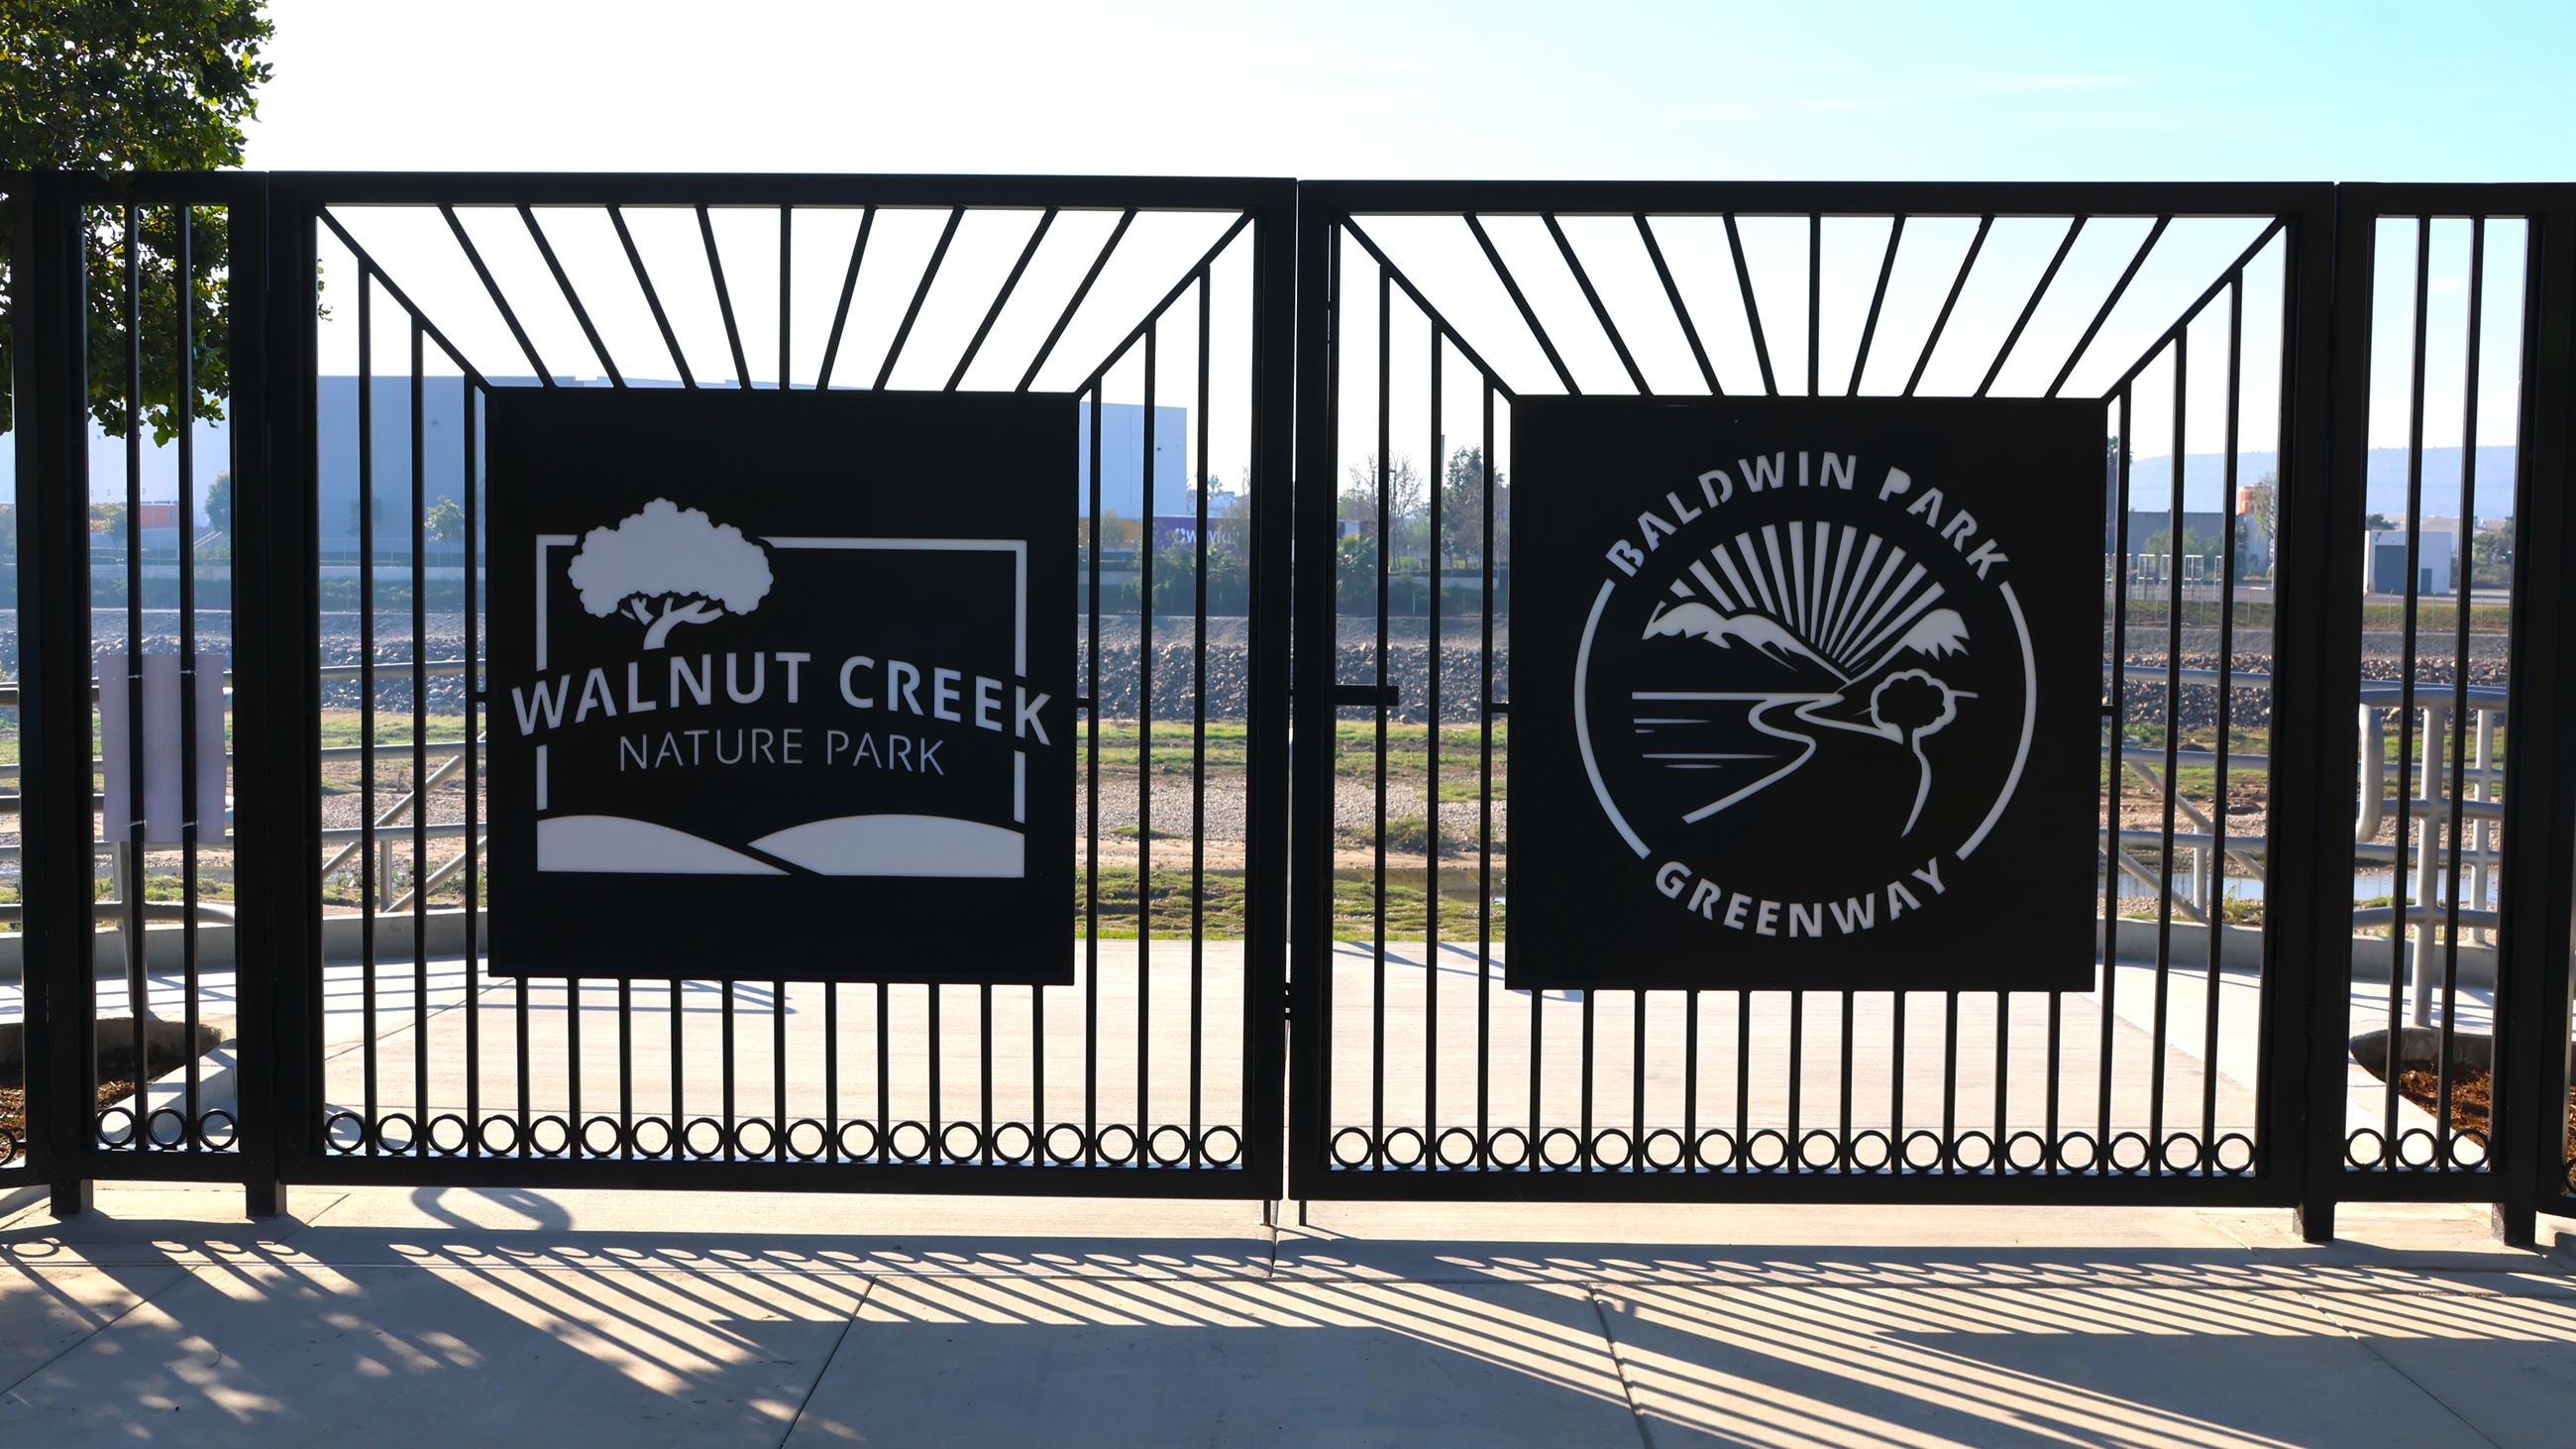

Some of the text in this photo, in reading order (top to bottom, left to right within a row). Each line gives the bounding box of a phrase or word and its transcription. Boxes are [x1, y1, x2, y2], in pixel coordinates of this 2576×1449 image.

[1605, 451, 2009, 581] BALDWIN PARK
[512, 651, 1051, 746] WALNUT CREEK
[620, 729, 944, 775] NATURE PARK
[1655, 856, 1946, 938] GREENWAY
